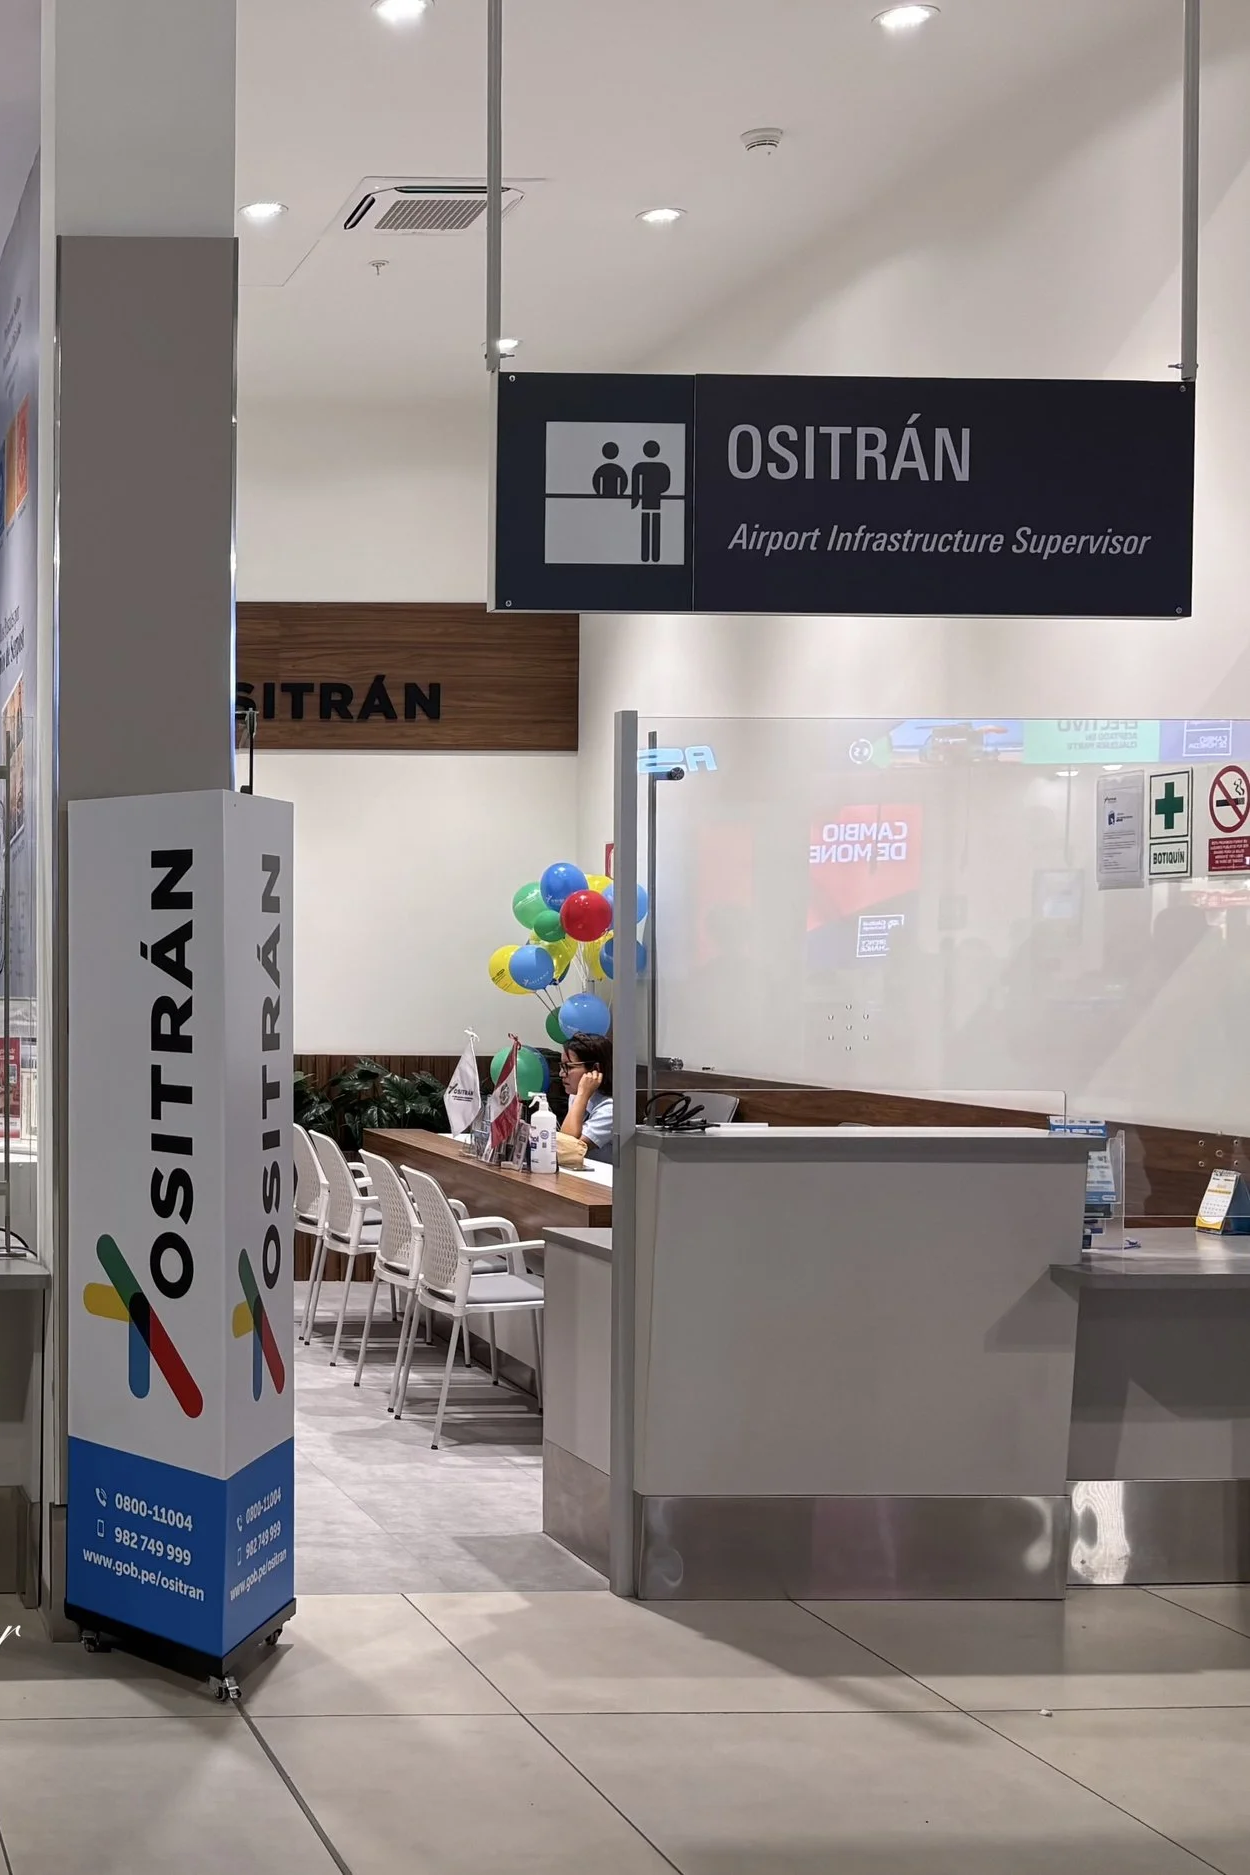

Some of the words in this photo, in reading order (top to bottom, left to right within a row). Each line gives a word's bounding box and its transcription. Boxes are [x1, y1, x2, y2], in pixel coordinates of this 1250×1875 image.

[727, 413, 971, 482] OSITRÁN
[728, 523, 821, 557] Airport
[826, 525, 1005, 554] Infrastructure
[1011, 526, 1152, 560] Supervisor
[236, 675, 442, 720] SITRÁN
[1152, 848, 1185, 865] BOTIQUÍN
[139, 848, 194, 1299] OSITRÁN
[255, 853, 282, 1290] OSITRÁN
[114, 1492, 194, 1532] 0800-11004
[245, 1486, 282, 1525] 0800-11004
[114, 1527, 139, 1550] 982
[140, 1535, 164, 1558] 749
[166, 1544, 192, 1566] 999
[245, 1537, 258, 1560] 982
[257, 1529, 269, 1550] 749
[269, 1520, 282, 1542] 999
[82, 1548, 205, 1602] www.gob.pe/ositran
[229, 1548, 287, 1602] www.gob.pe/ositran
